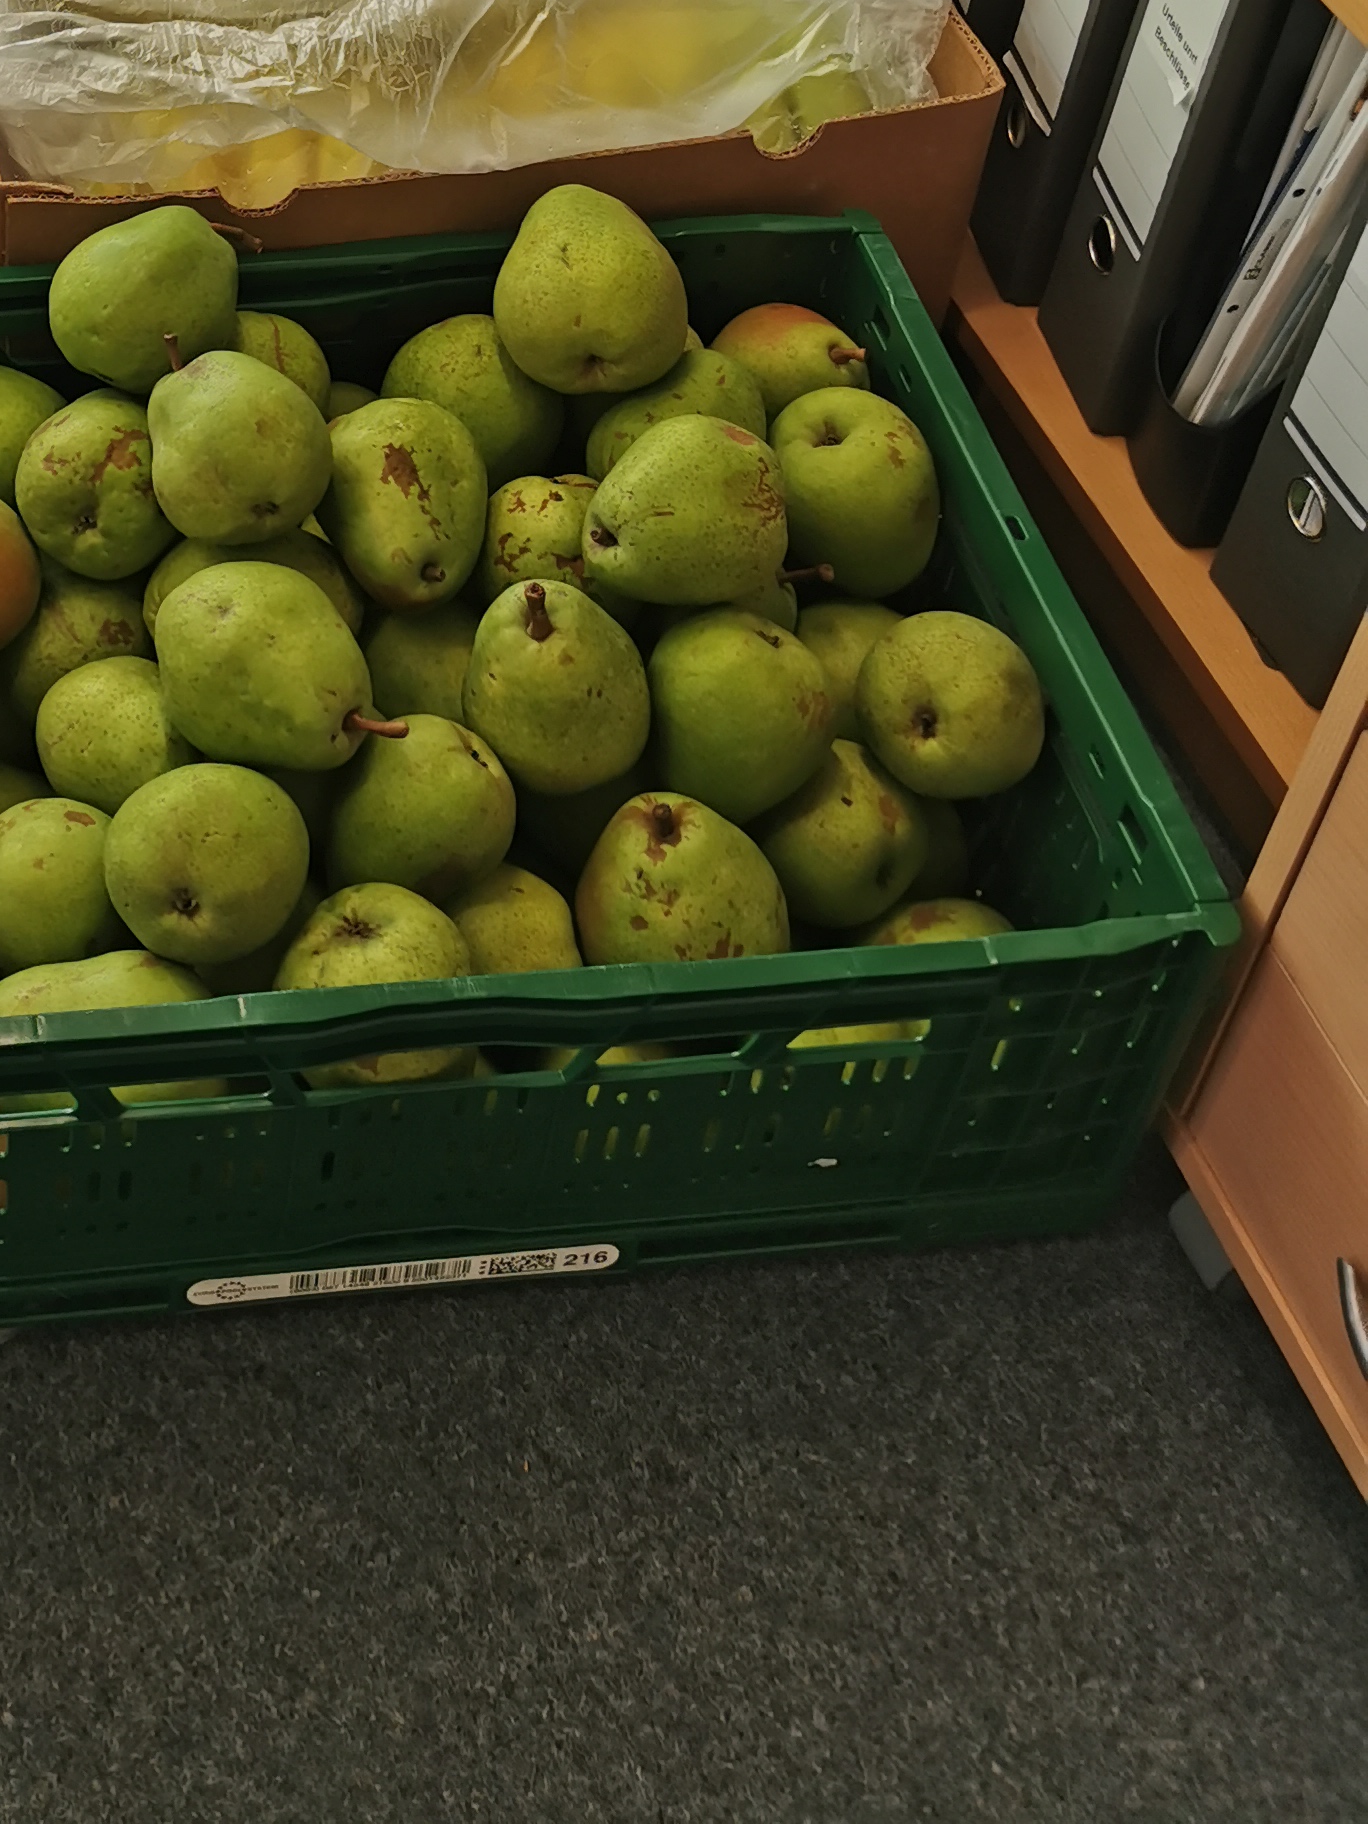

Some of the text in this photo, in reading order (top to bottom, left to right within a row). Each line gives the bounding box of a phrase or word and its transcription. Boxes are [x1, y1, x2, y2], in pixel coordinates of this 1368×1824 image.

[1154, 25, 1191, 91] Beschlüsse
[1162, 3, 1198, 65] Urteile und
[562, 1250, 609, 1267] 216
